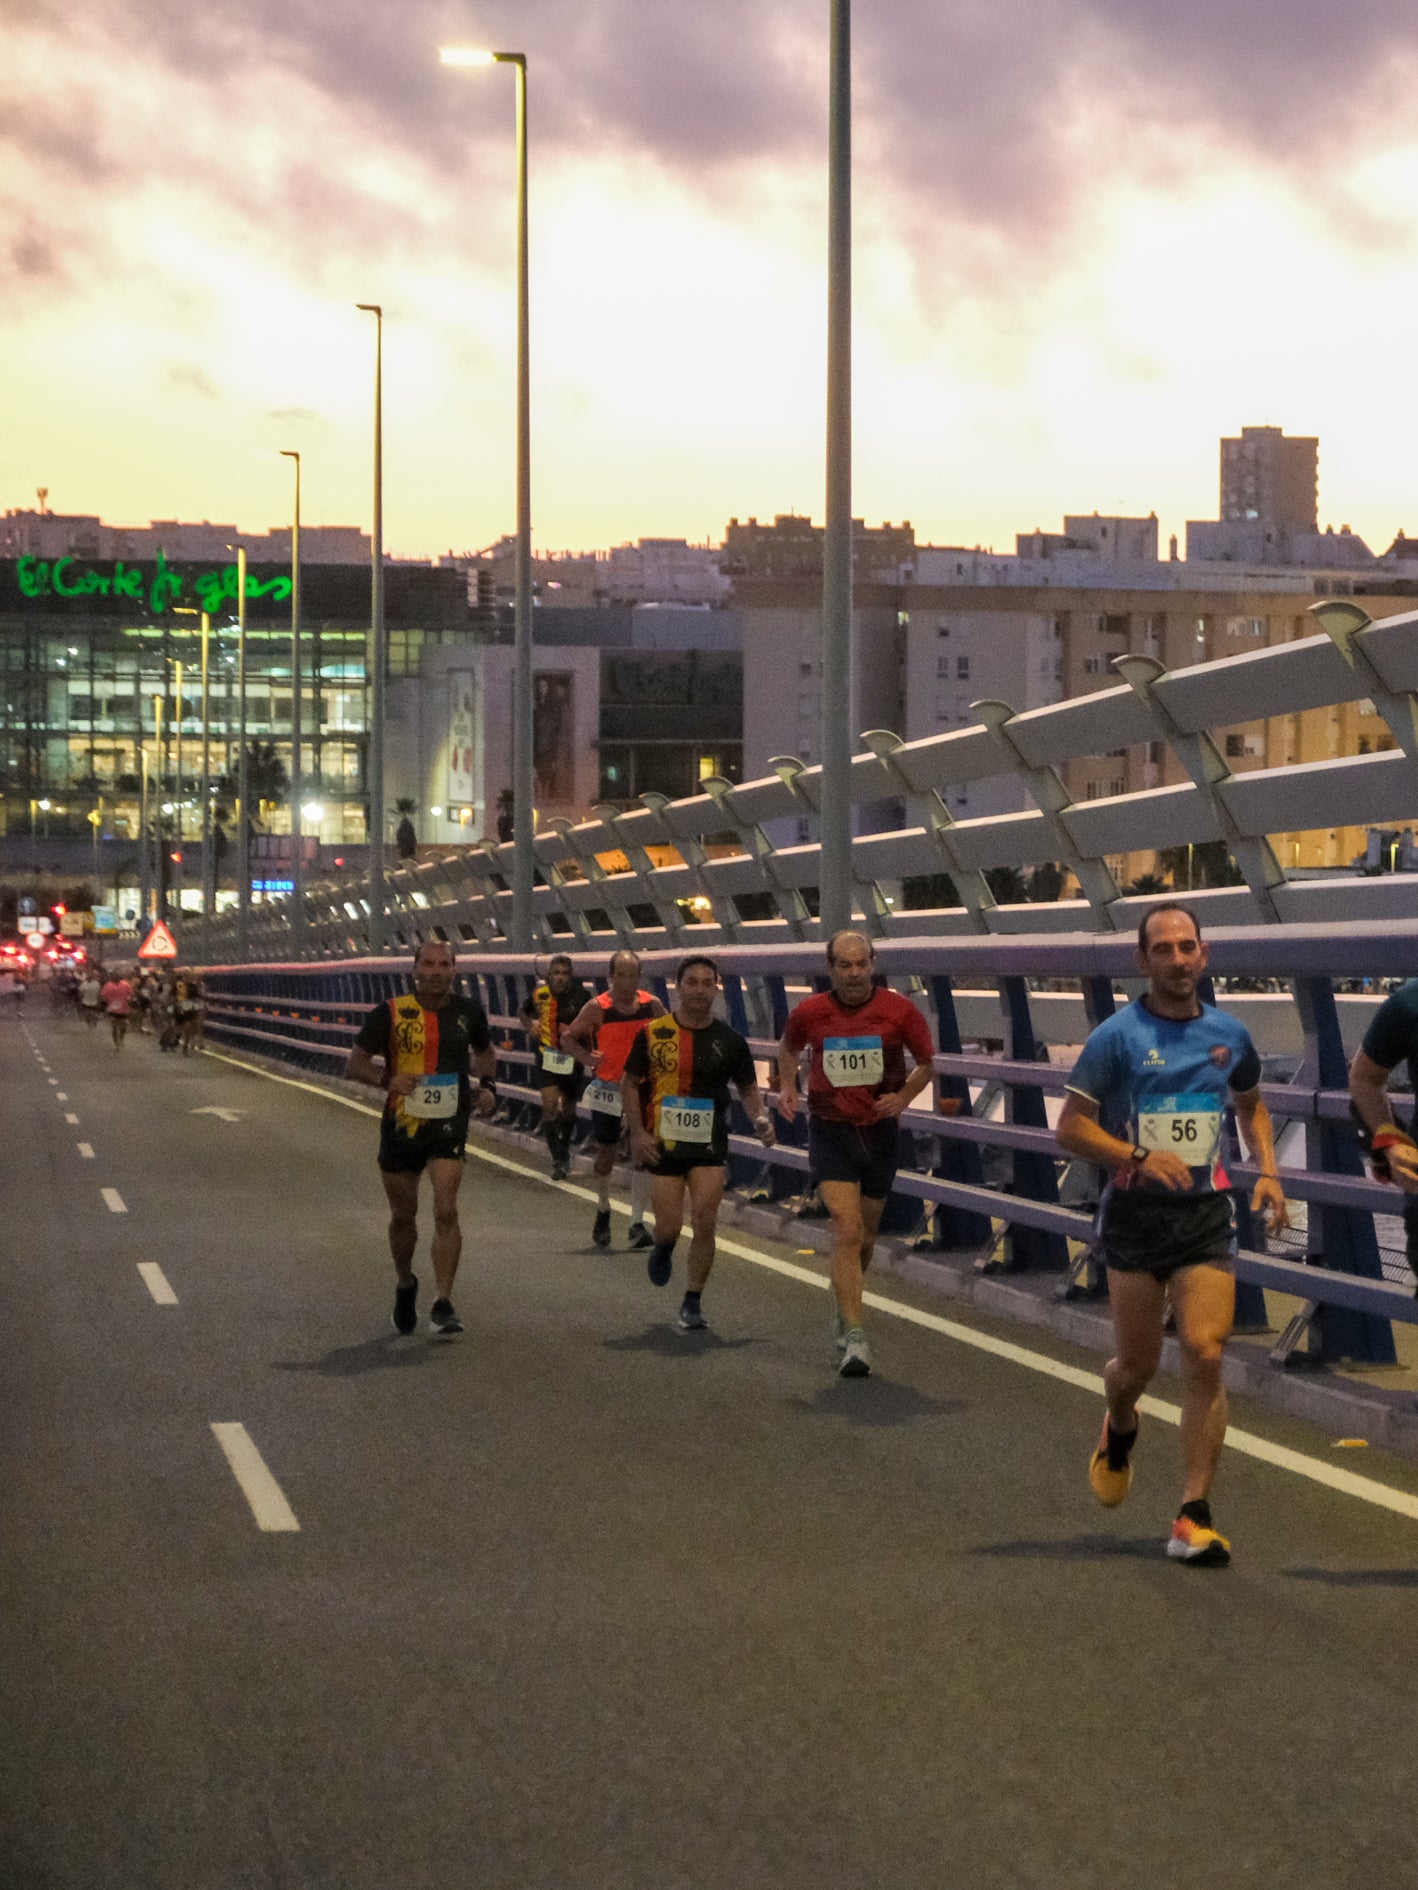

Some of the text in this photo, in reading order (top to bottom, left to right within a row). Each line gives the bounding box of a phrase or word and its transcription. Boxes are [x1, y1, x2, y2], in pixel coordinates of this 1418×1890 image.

[52, 555, 144, 597] Corte
[839, 1053, 866, 1070] 101
[423, 1089, 441, 1104] 29
[594, 1090, 614, 1103] 210
[676, 1111, 701, 1128] 108
[1170, 1118, 1198, 1143] 56
